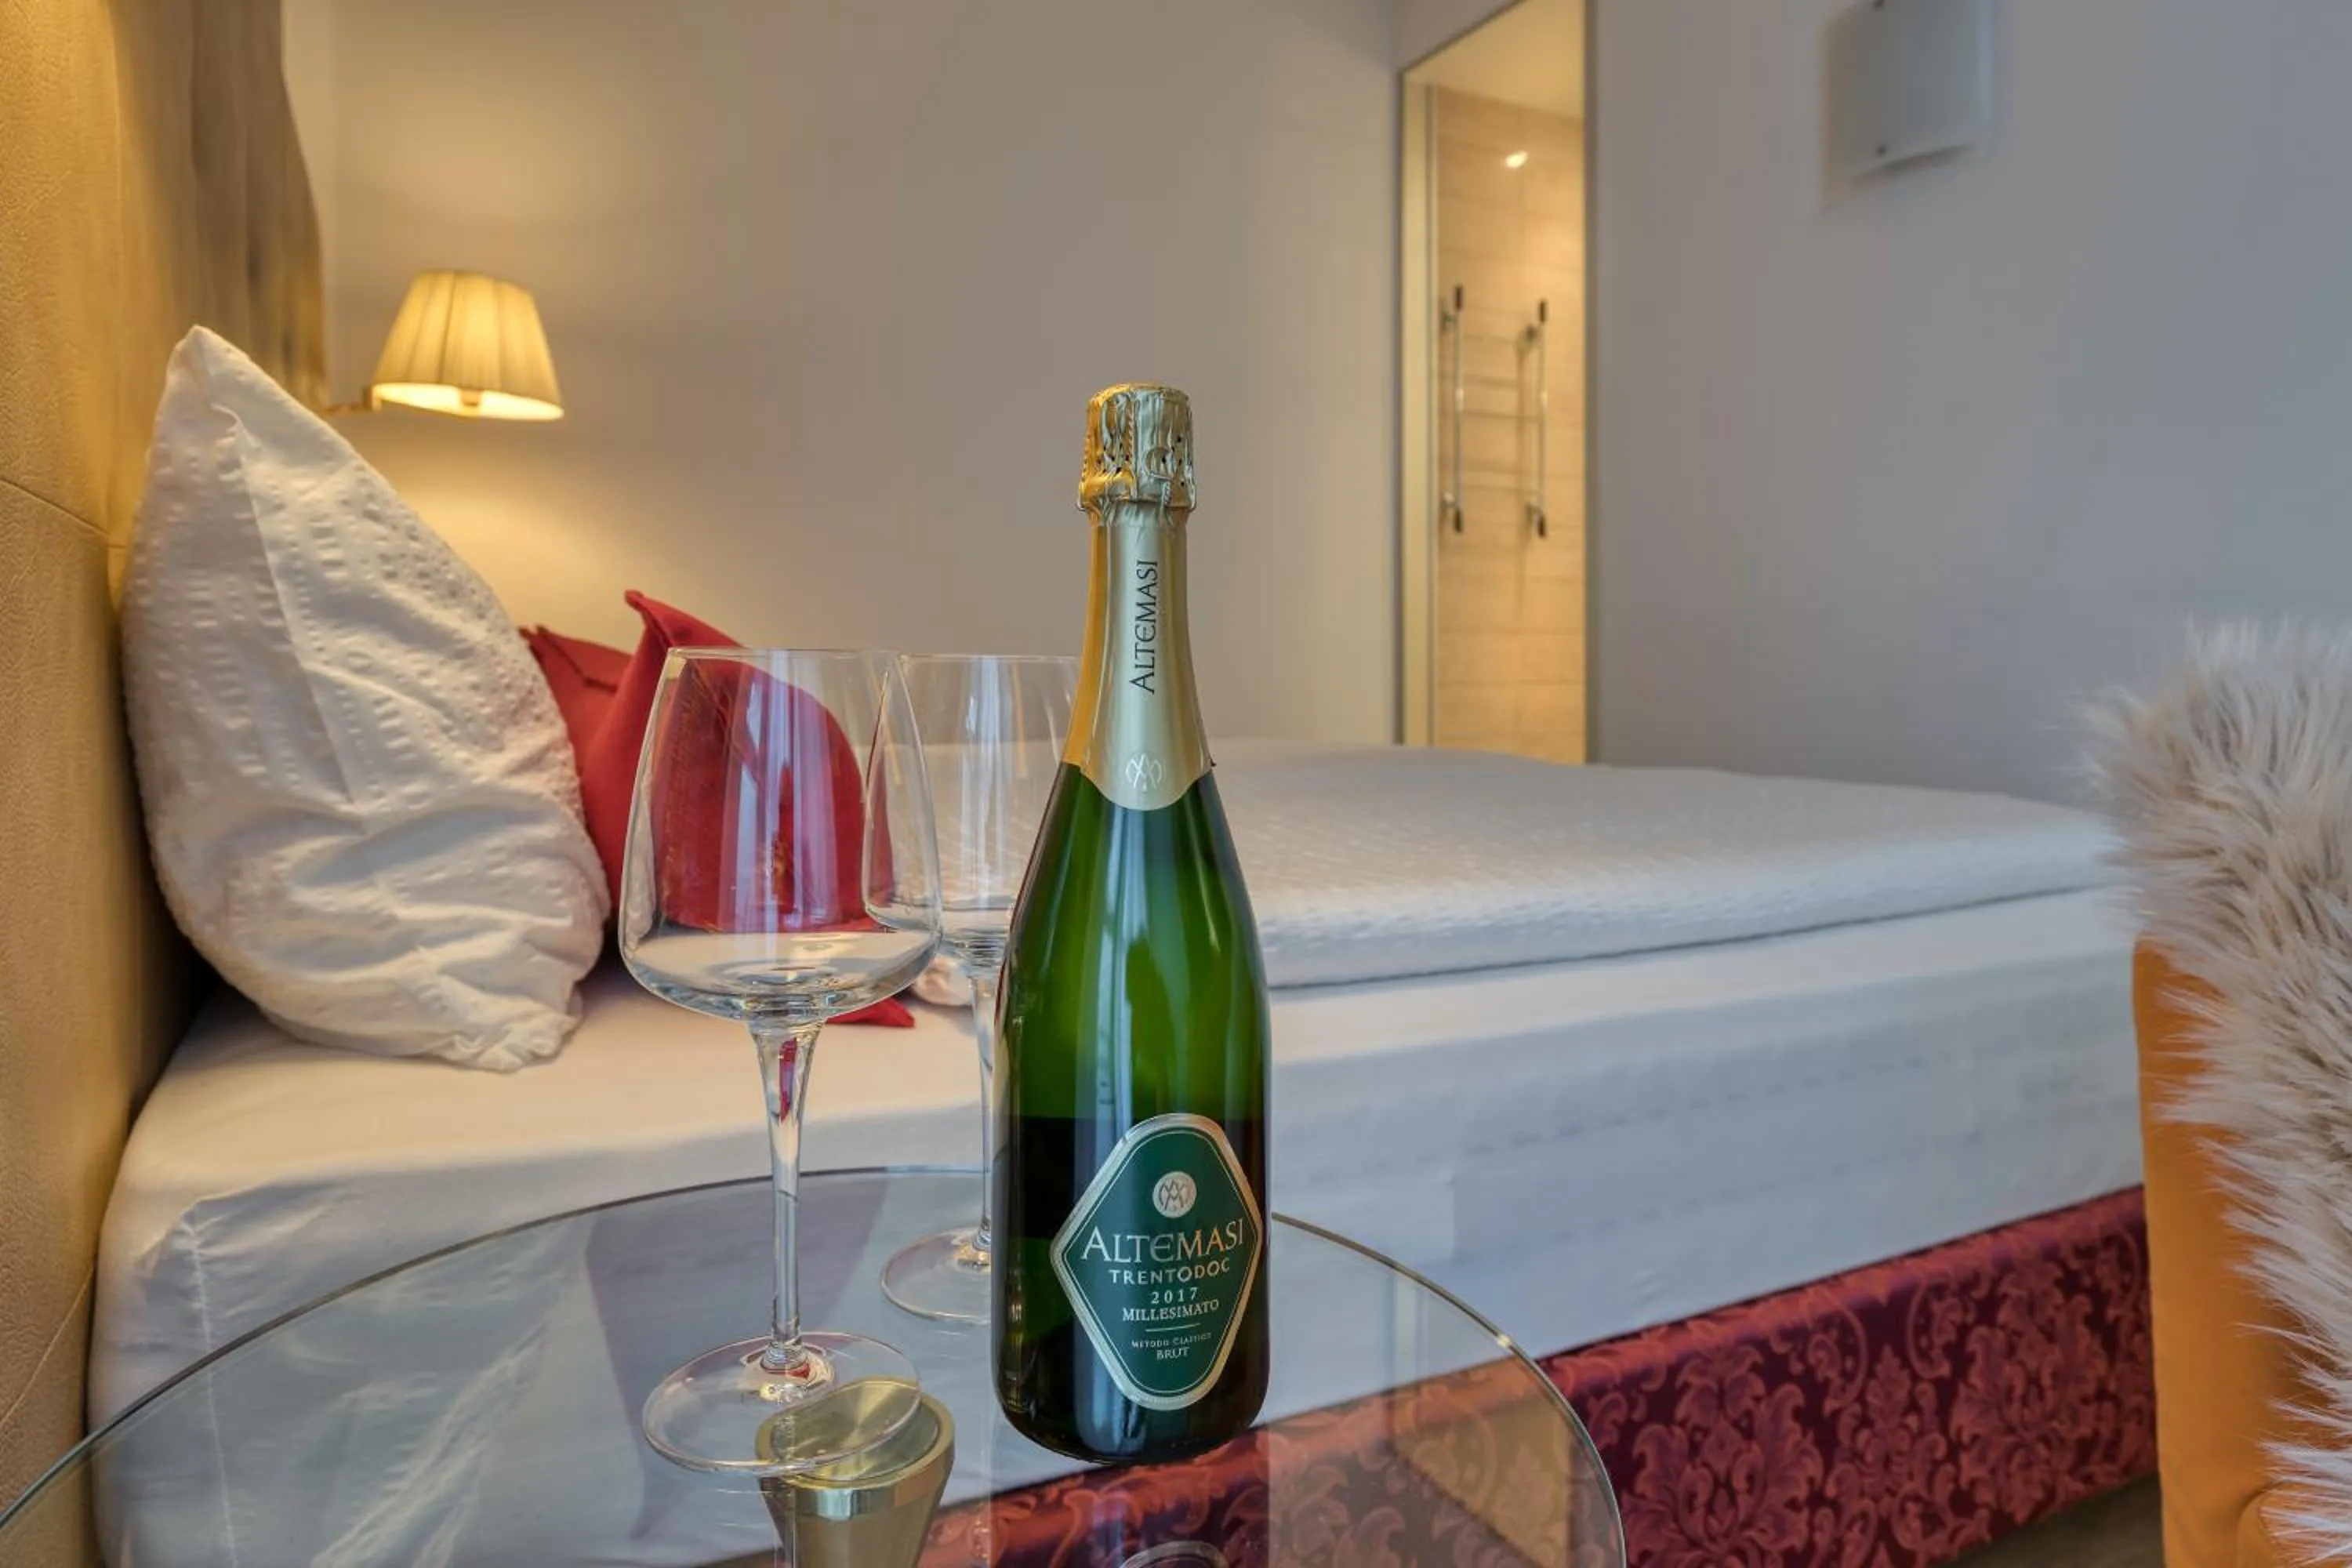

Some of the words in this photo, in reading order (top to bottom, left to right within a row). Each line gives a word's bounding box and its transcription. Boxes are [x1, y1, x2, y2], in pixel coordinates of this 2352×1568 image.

[1129, 560, 1158, 695] ALTEMASI
[1080, 1217, 1243, 1263] ALTEMASI
[1108, 1258, 1230, 1285] TRENTODOC
[1152, 1287, 1199, 1305] 2017
[1122, 1299, 1220, 1322] MILLESIMATO
[1156, 1347, 1190, 1360] BRUT
